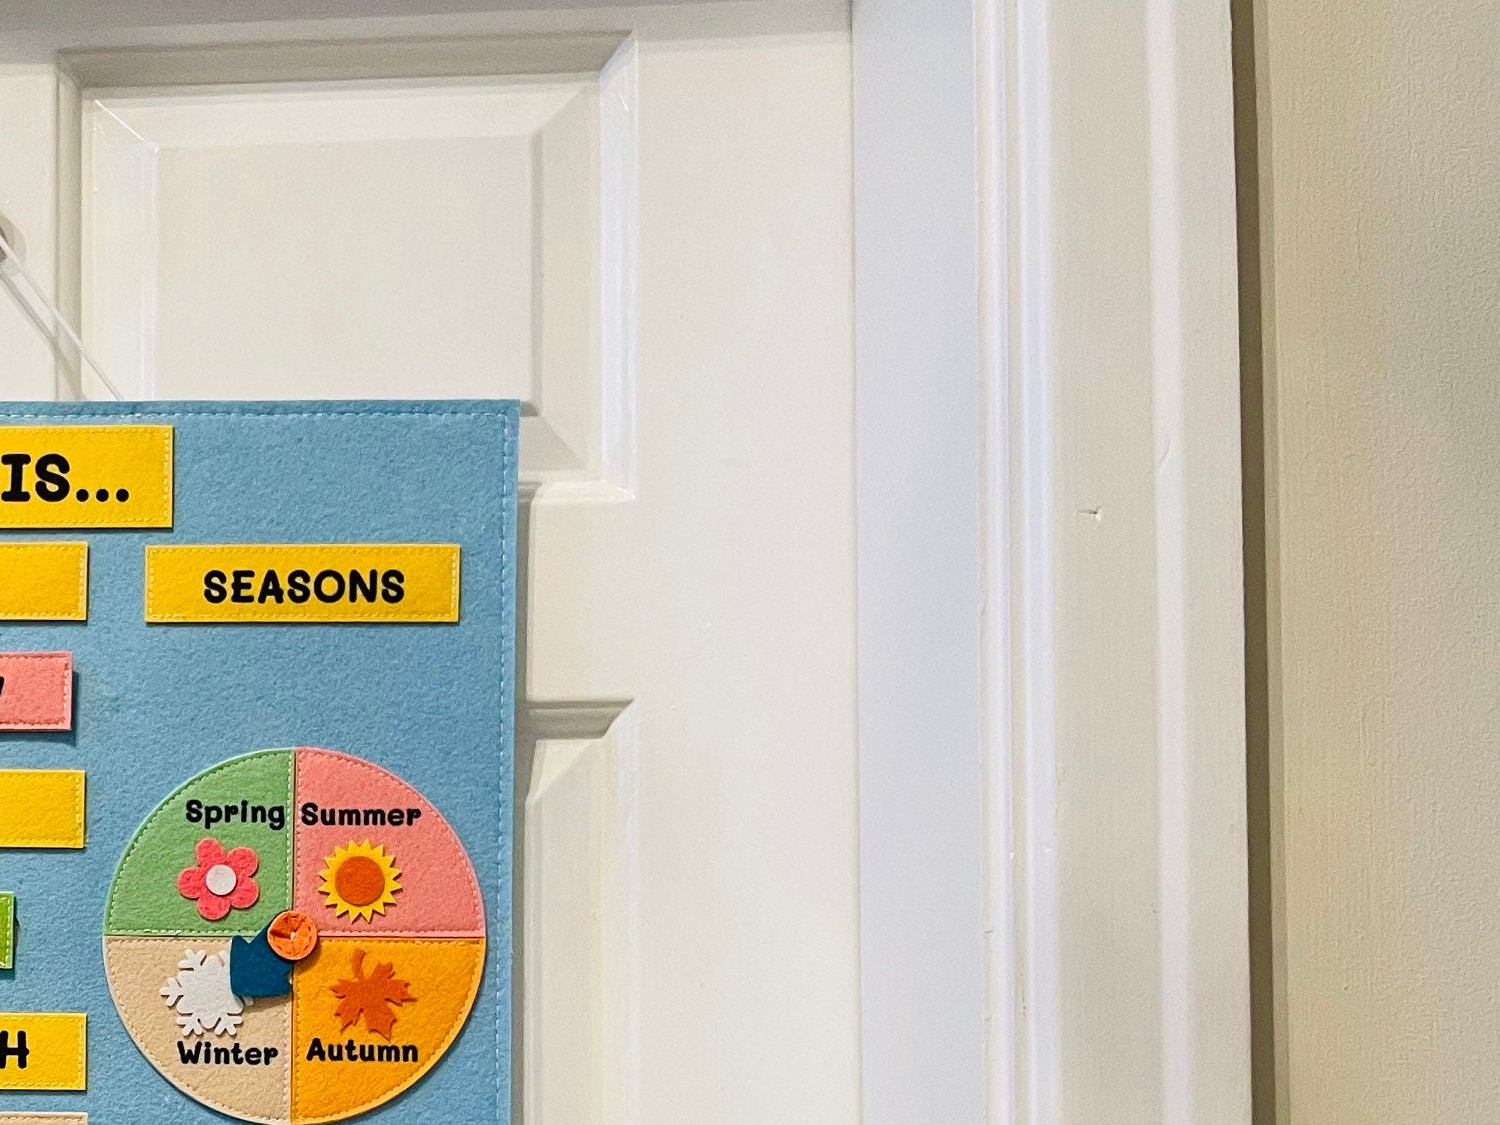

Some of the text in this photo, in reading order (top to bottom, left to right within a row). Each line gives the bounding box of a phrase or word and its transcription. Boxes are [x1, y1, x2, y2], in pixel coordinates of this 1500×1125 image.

[1, 454, 129, 502] IS...
[204, 569, 404, 604] SEASONS
[186, 800, 285, 830] Spring
[301, 803, 421, 826] Summer
[177, 1041, 278, 1065] Winter
[307, 1038, 418, 1062] Autumn
